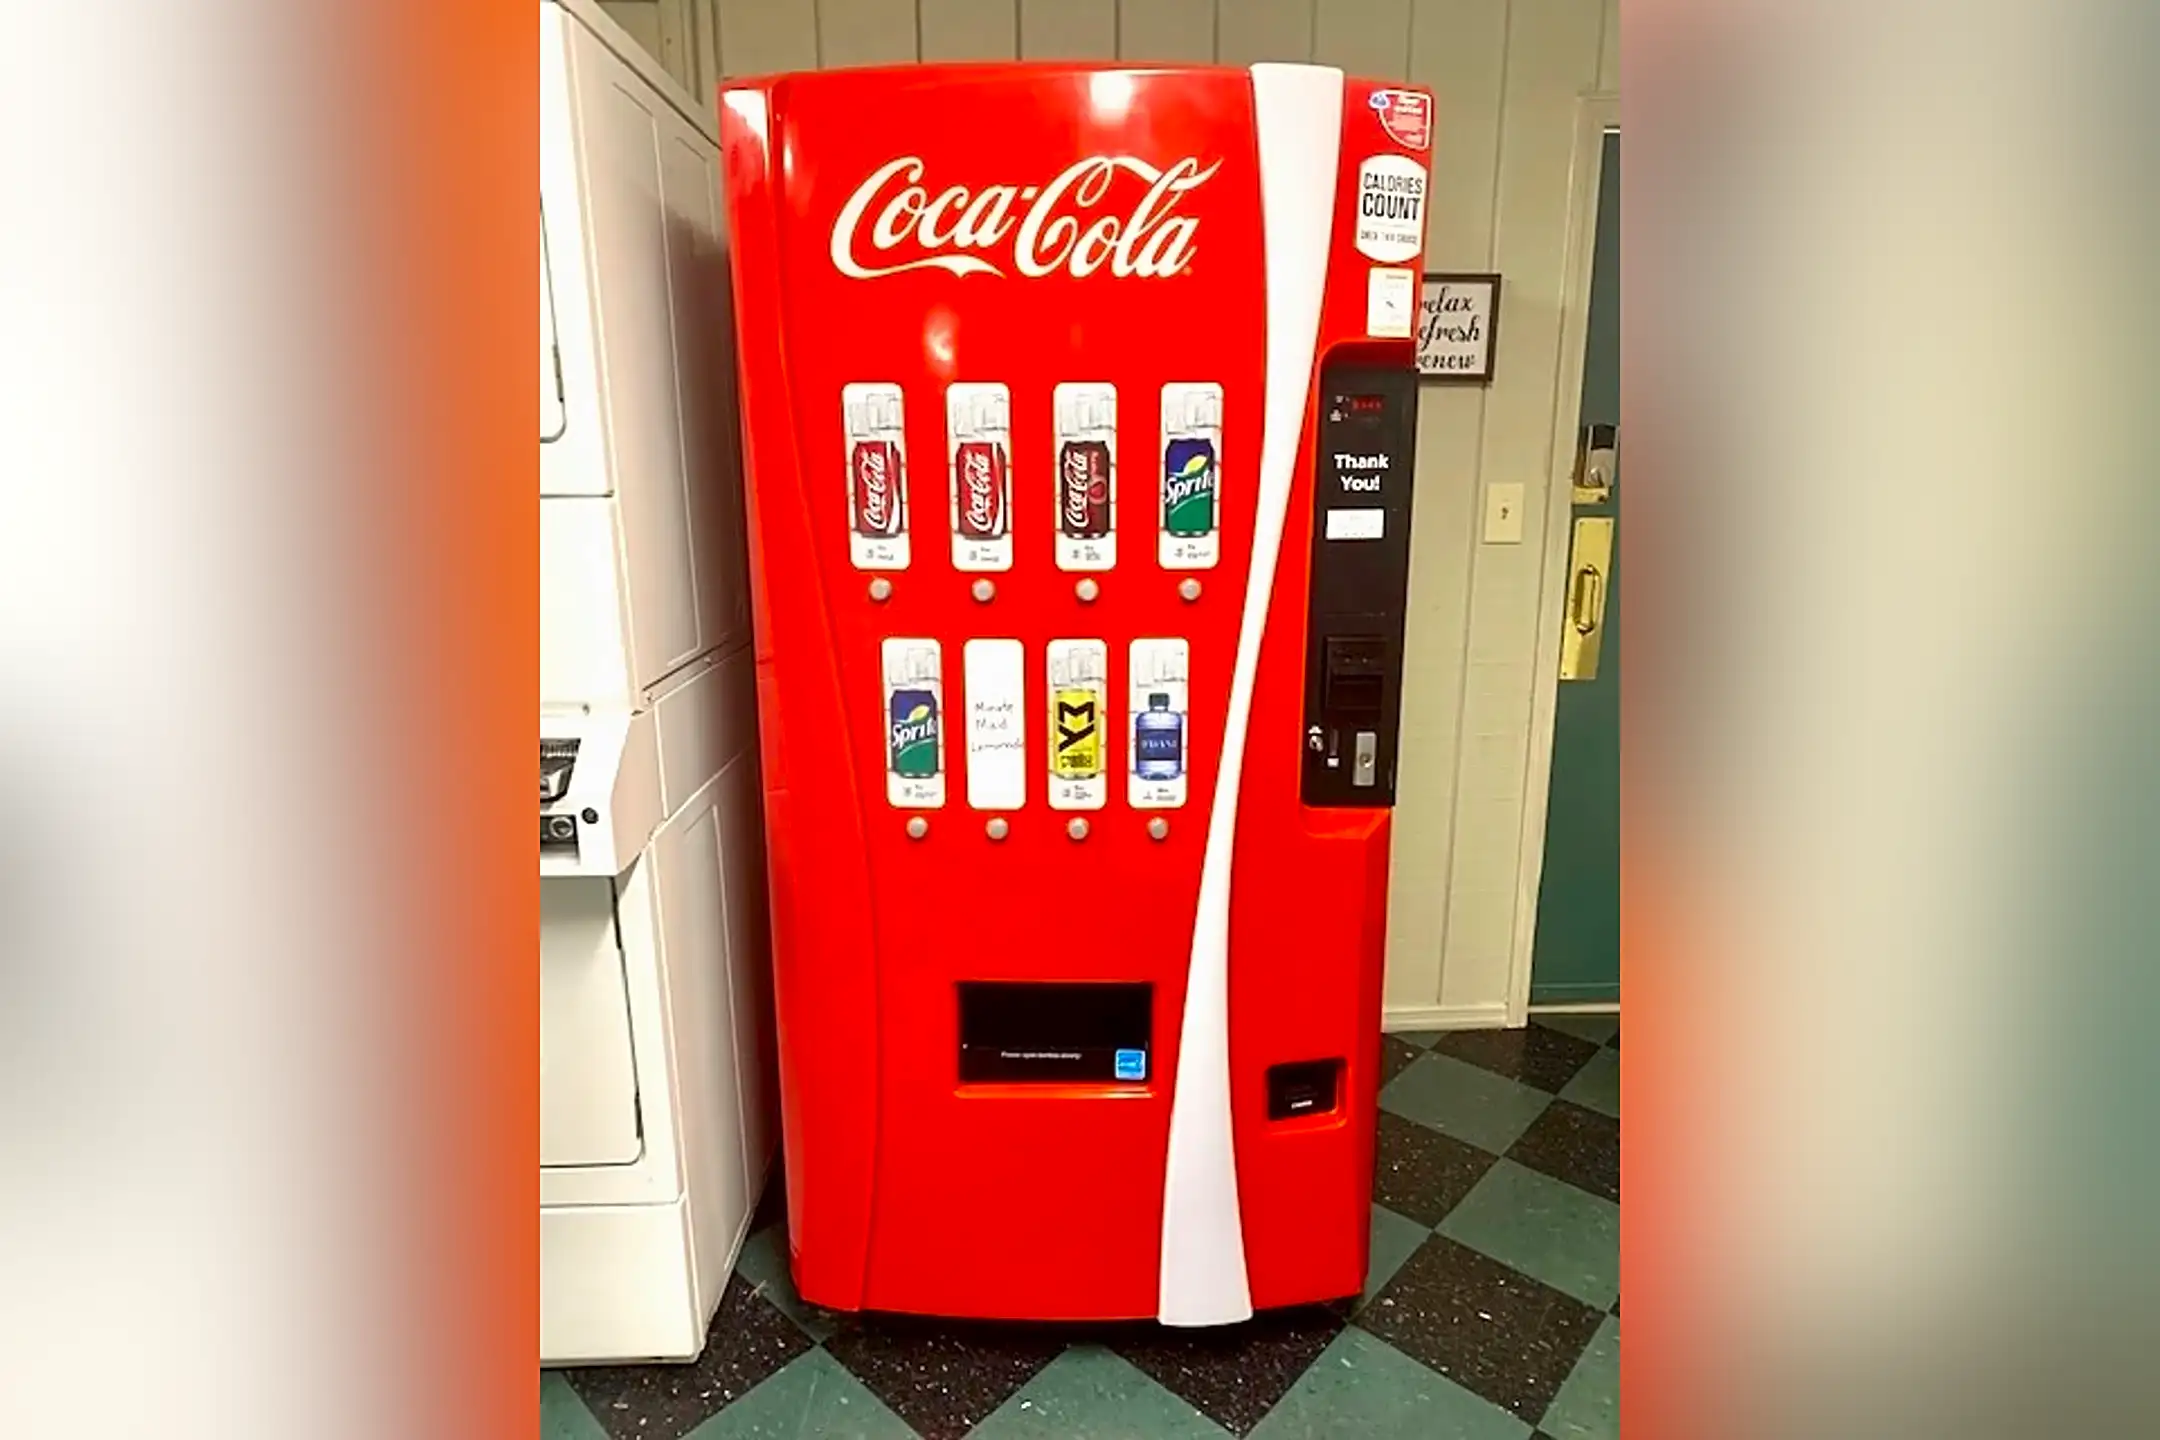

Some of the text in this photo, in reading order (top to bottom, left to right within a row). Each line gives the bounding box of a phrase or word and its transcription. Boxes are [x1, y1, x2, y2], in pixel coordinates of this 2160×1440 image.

[1362, 172, 1423, 195] CALORIES
[829, 155, 1224, 279] Coca-Cola
[1362, 192, 1421, 221] COUNT
[1418, 314, 1480, 352] efresh
[1334, 454, 1390, 470] Thank
[1340, 475, 1381, 491] You!
